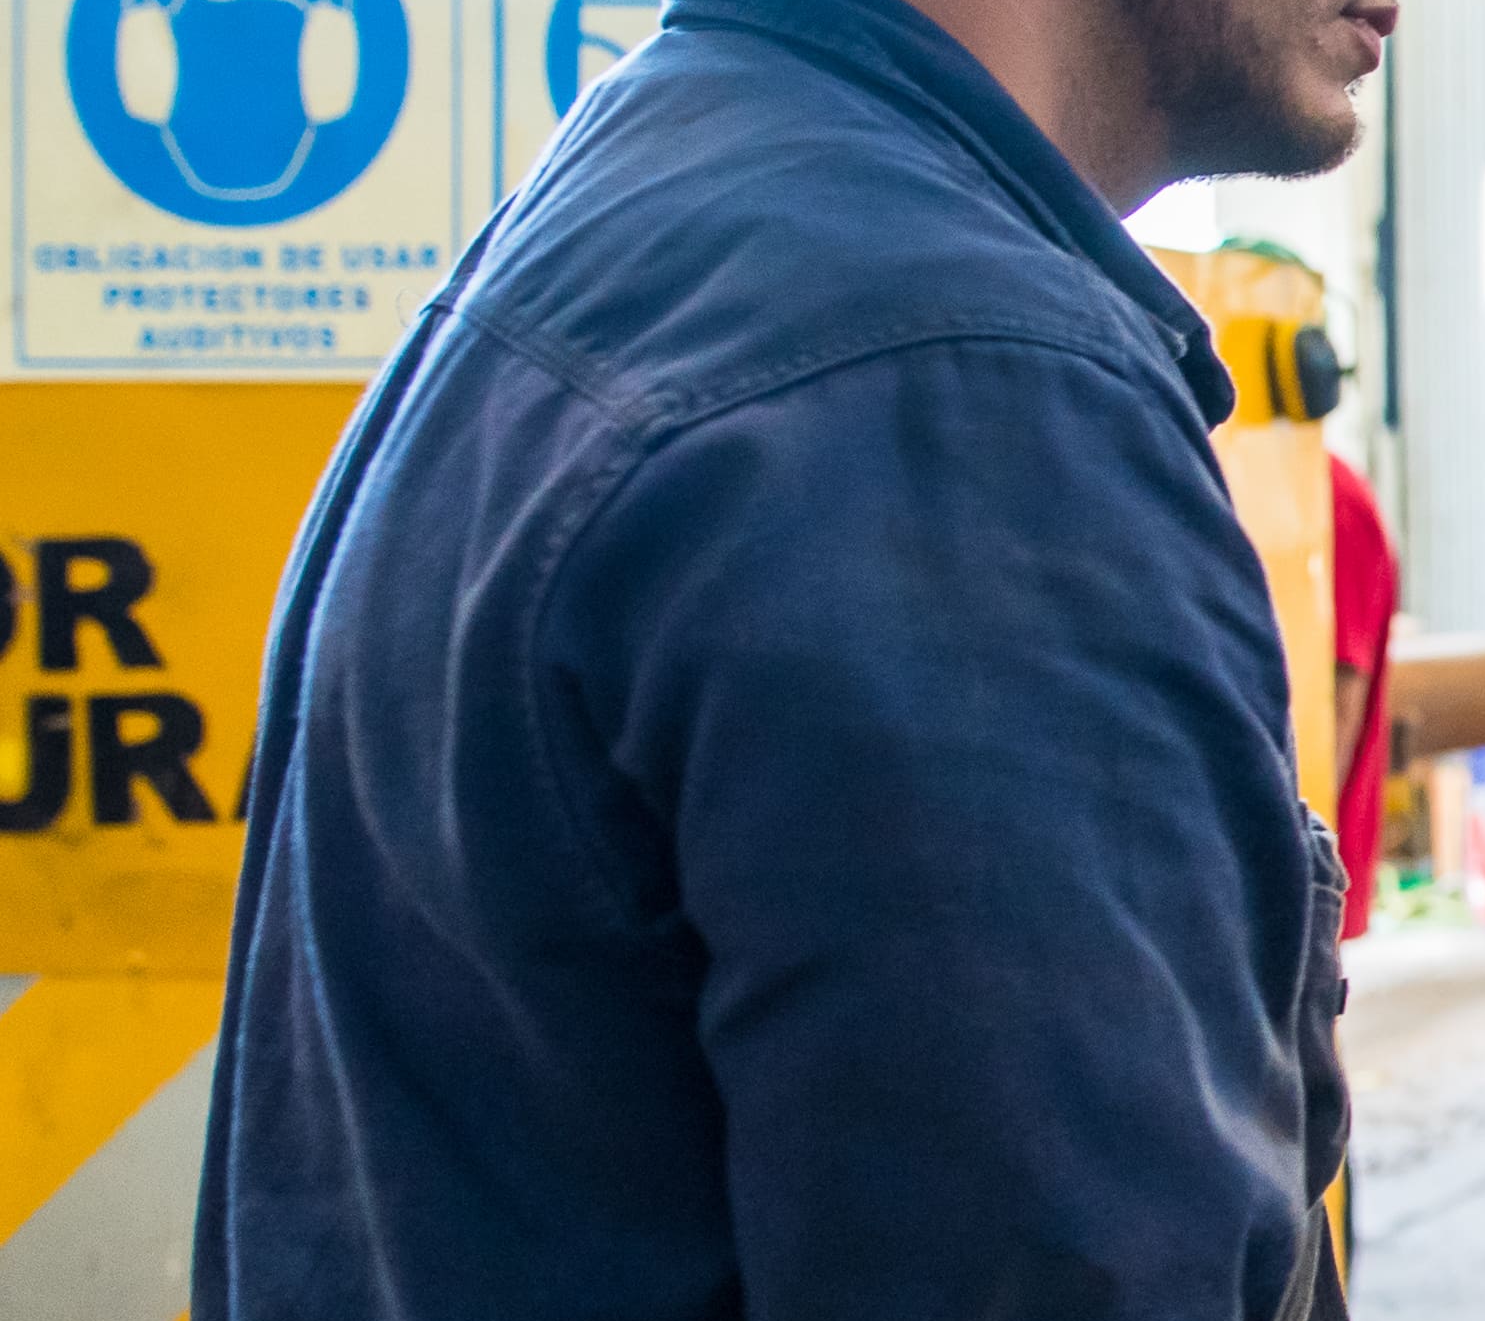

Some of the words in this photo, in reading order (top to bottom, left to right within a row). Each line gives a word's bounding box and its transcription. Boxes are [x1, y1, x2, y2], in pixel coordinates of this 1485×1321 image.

[281, 246, 323, 272] DE
[342, 245, 437, 271] USAR
[104, 286, 369, 312] PROTECTORES
[140, 326, 335, 350] AUDITIVOS
[0, 534, 164, 672] R
[0, 692, 256, 834] UR
